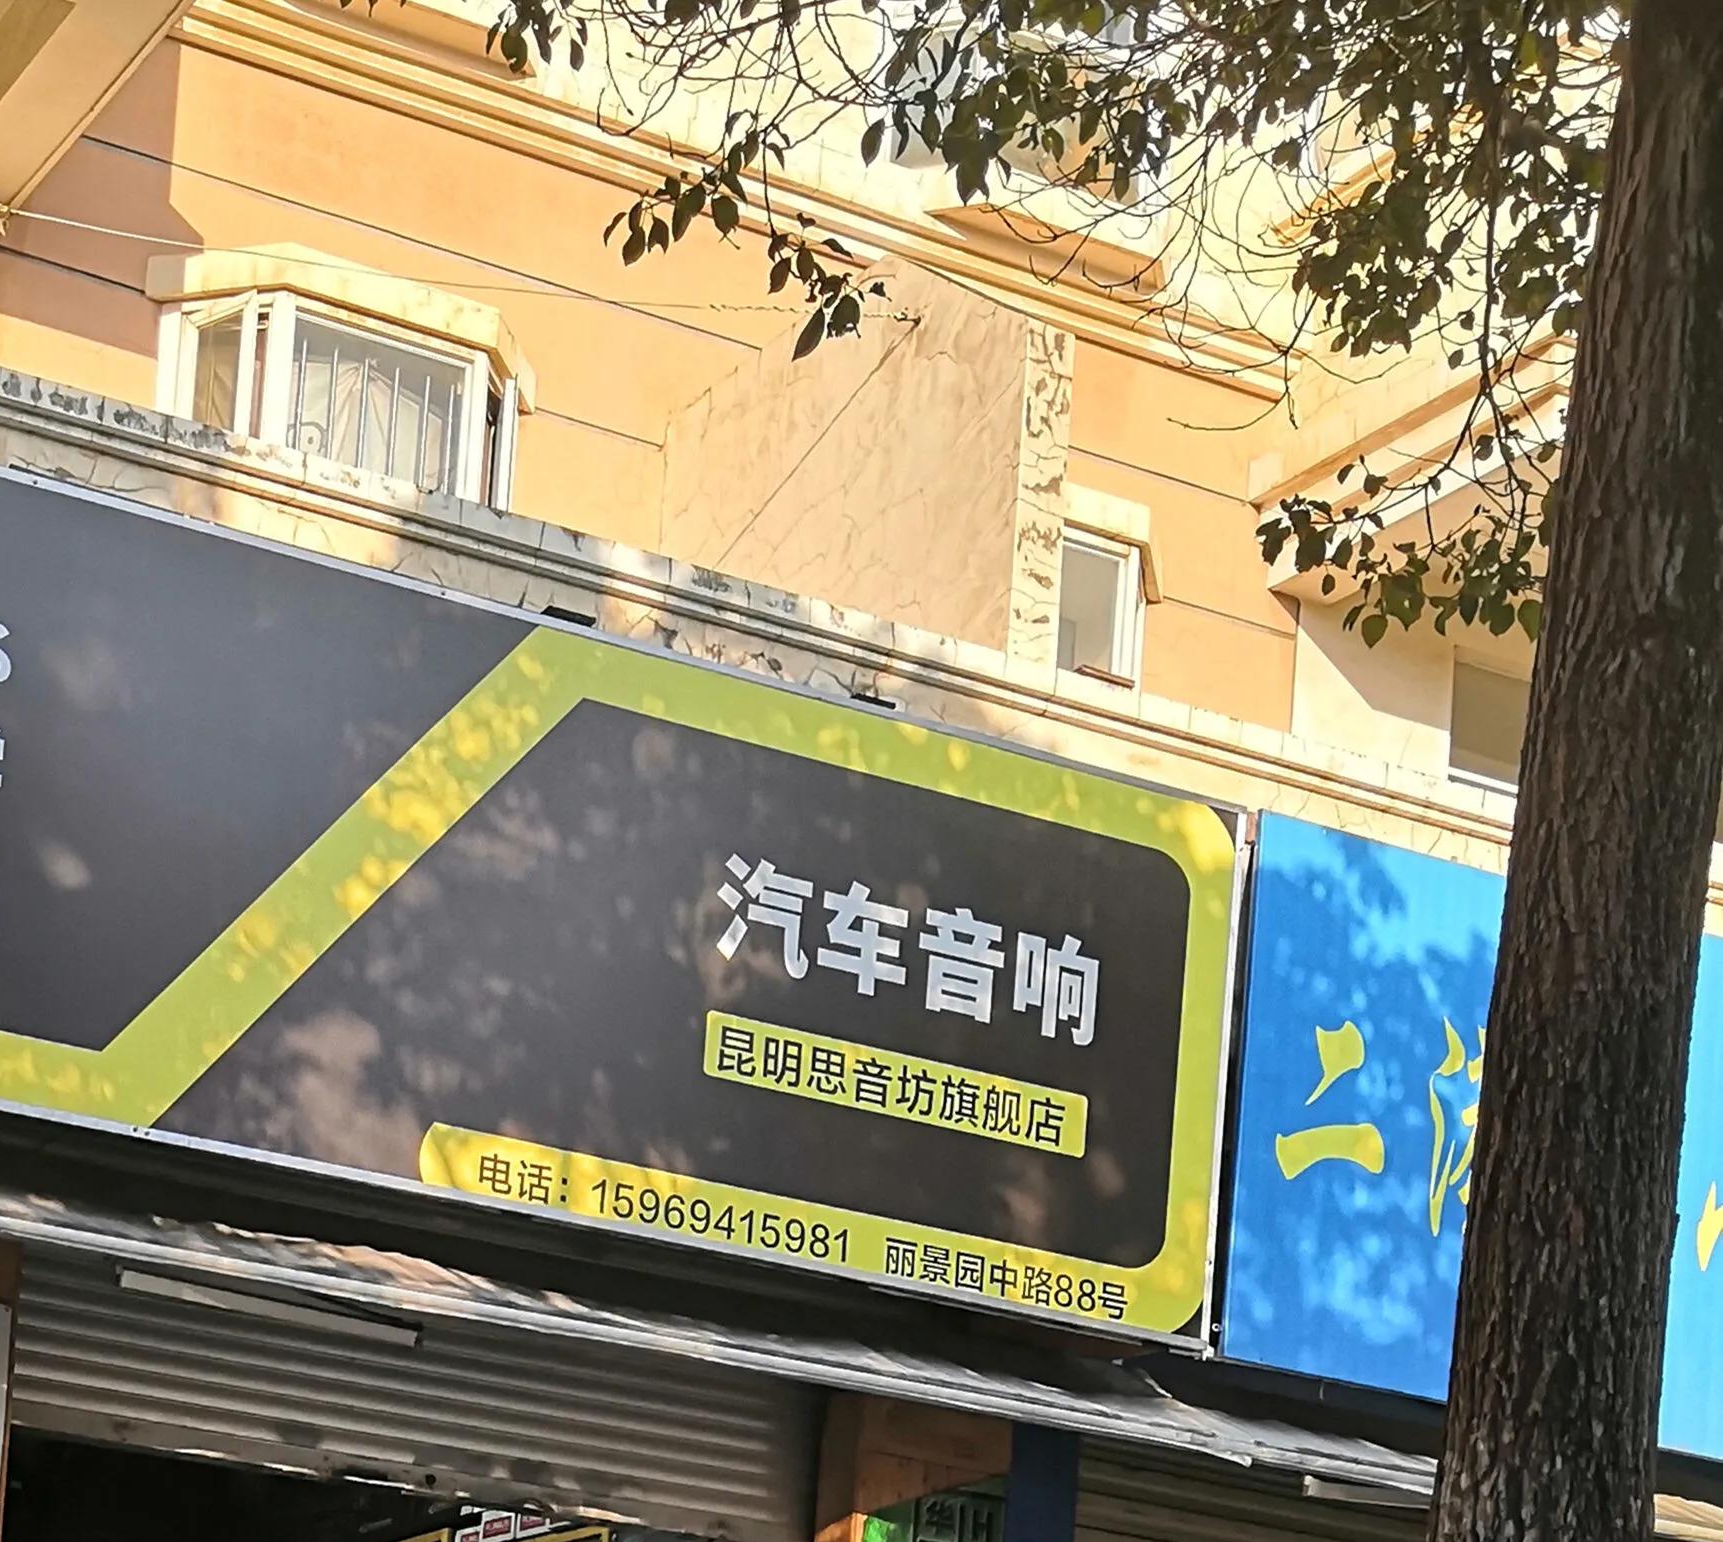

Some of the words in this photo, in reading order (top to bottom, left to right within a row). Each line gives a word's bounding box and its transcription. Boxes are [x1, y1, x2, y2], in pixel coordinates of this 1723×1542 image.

[716, 852, 1101, 1046] 汽车音响
[715, 1024, 1066, 1148] 昆明思音坊旗舰店
[884, 1235, 1130, 1321] 丽景园中路88号
